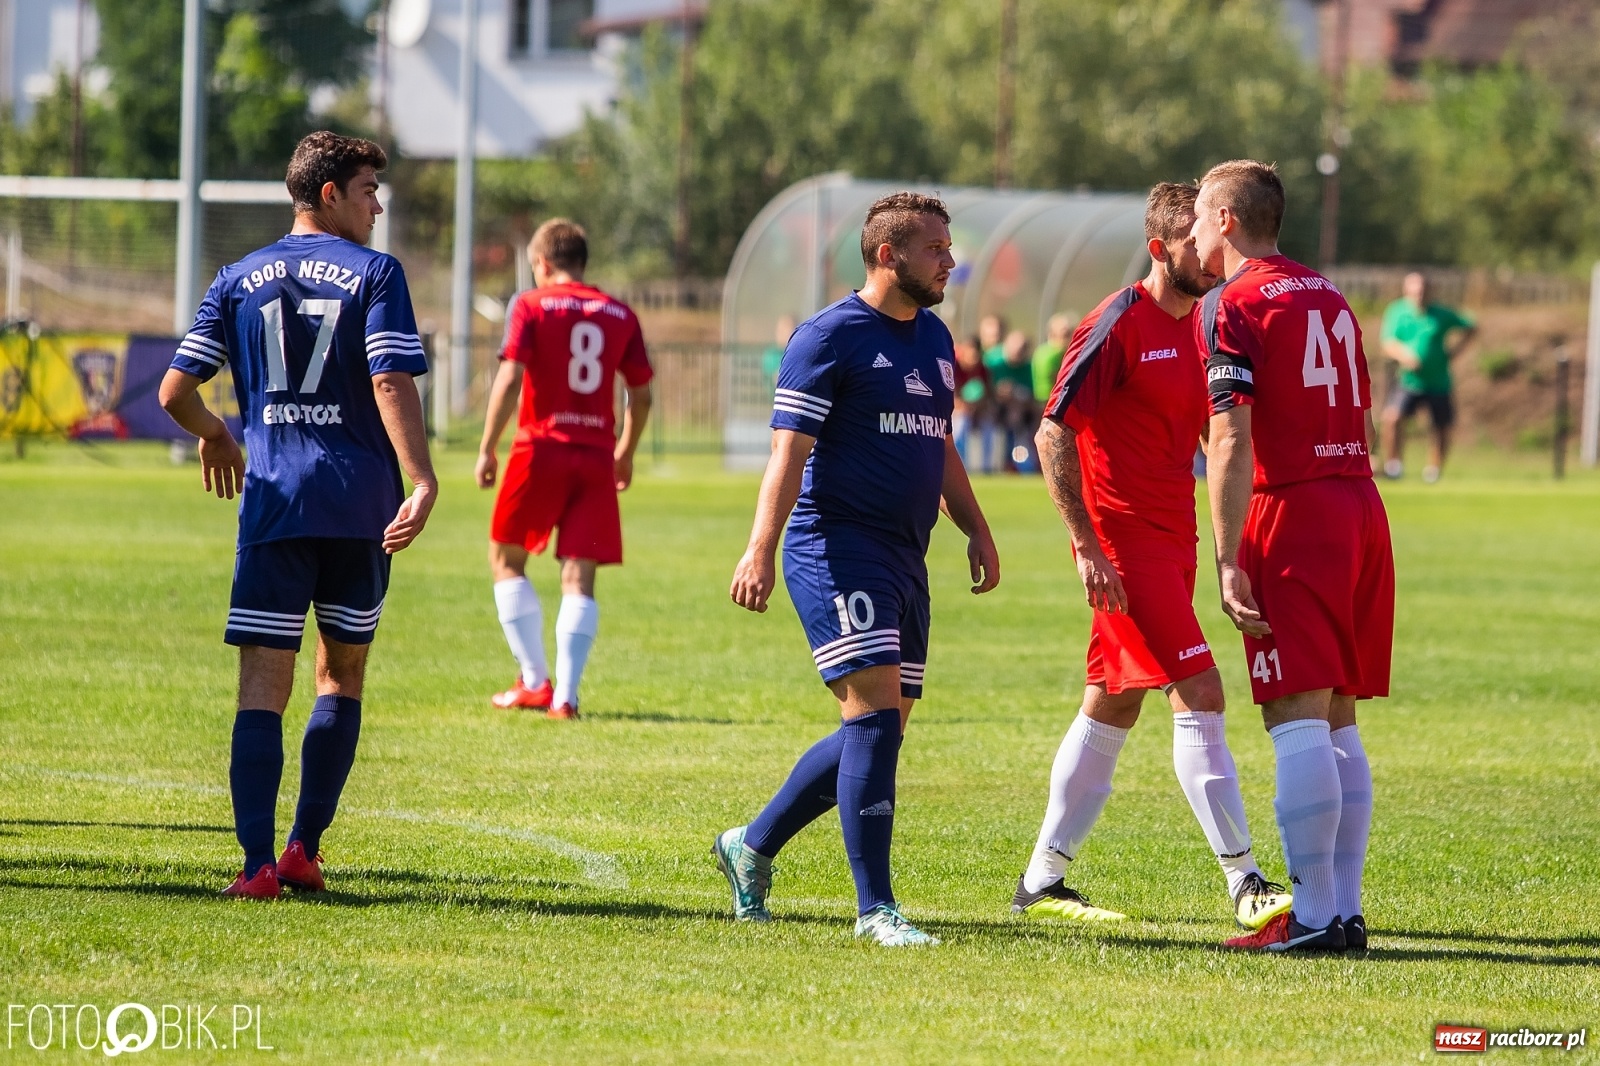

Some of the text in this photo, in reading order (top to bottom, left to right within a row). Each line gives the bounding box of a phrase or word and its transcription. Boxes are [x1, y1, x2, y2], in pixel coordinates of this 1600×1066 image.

[242, 260, 362, 295] 1908 NĘDZA
[259, 297, 342, 394] 17
[568, 320, 605, 395] 8
[1141, 348, 1178, 362] LEGEA
[1302, 309, 1362, 407] 41
[833, 590, 875, 636] 10
[1252, 648, 1282, 684] 41
[860, 808, 894, 816] adidas
